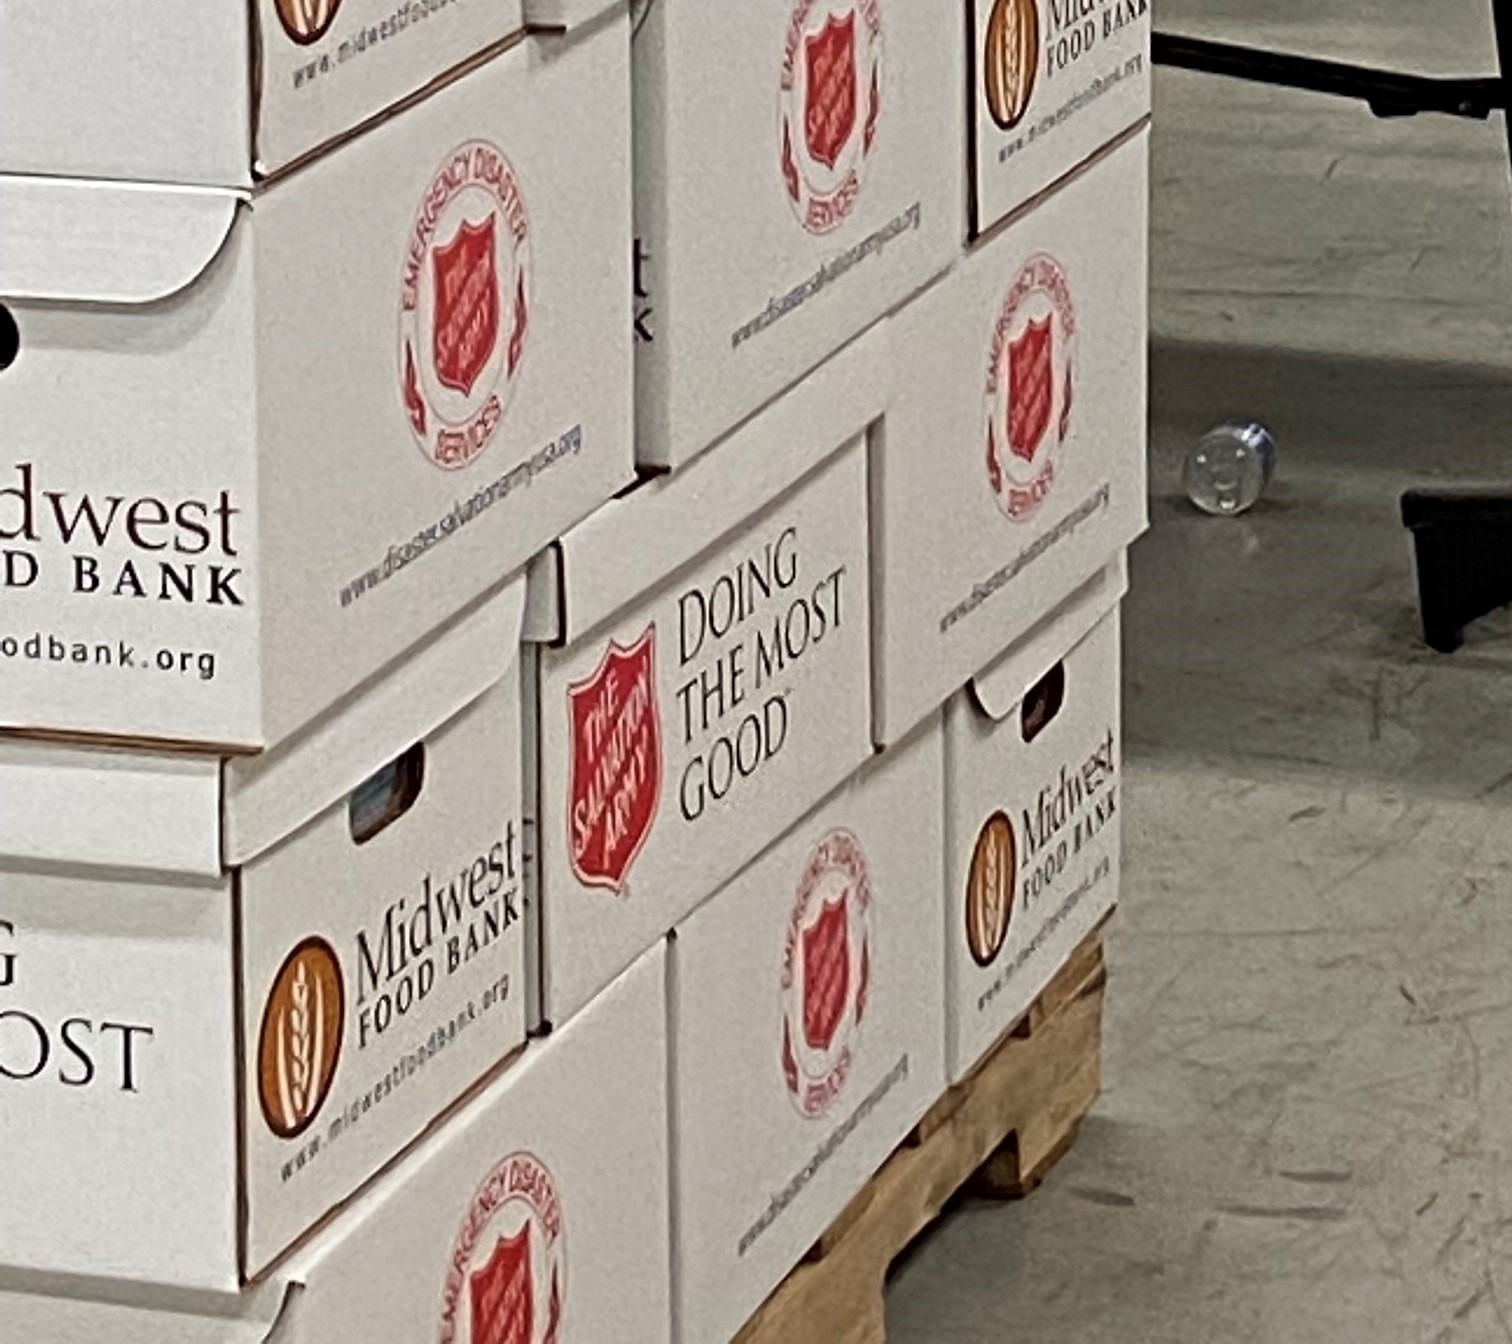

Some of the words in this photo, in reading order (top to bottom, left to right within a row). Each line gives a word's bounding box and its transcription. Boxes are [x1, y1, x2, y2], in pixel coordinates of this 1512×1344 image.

[1047, 20, 1095, 78] FOOD
[73, 555, 244, 606] BANK
[678, 526, 797, 667] DOING
[584, 667, 620, 762] THE
[676, 644, 746, 745] THE
[754, 565, 846, 689] MOST
[573, 655, 650, 861] SALVATION
[602, 723, 649, 870] ARMY
[679, 695, 788, 821] GOOD
[1021, 727, 1115, 868] Midwest
[356, 820, 516, 1008] Midwest
[1022, 840, 1068, 910] FOOD
[358, 957, 435, 1050] FOOD
[446, 887, 519, 975] BANK
